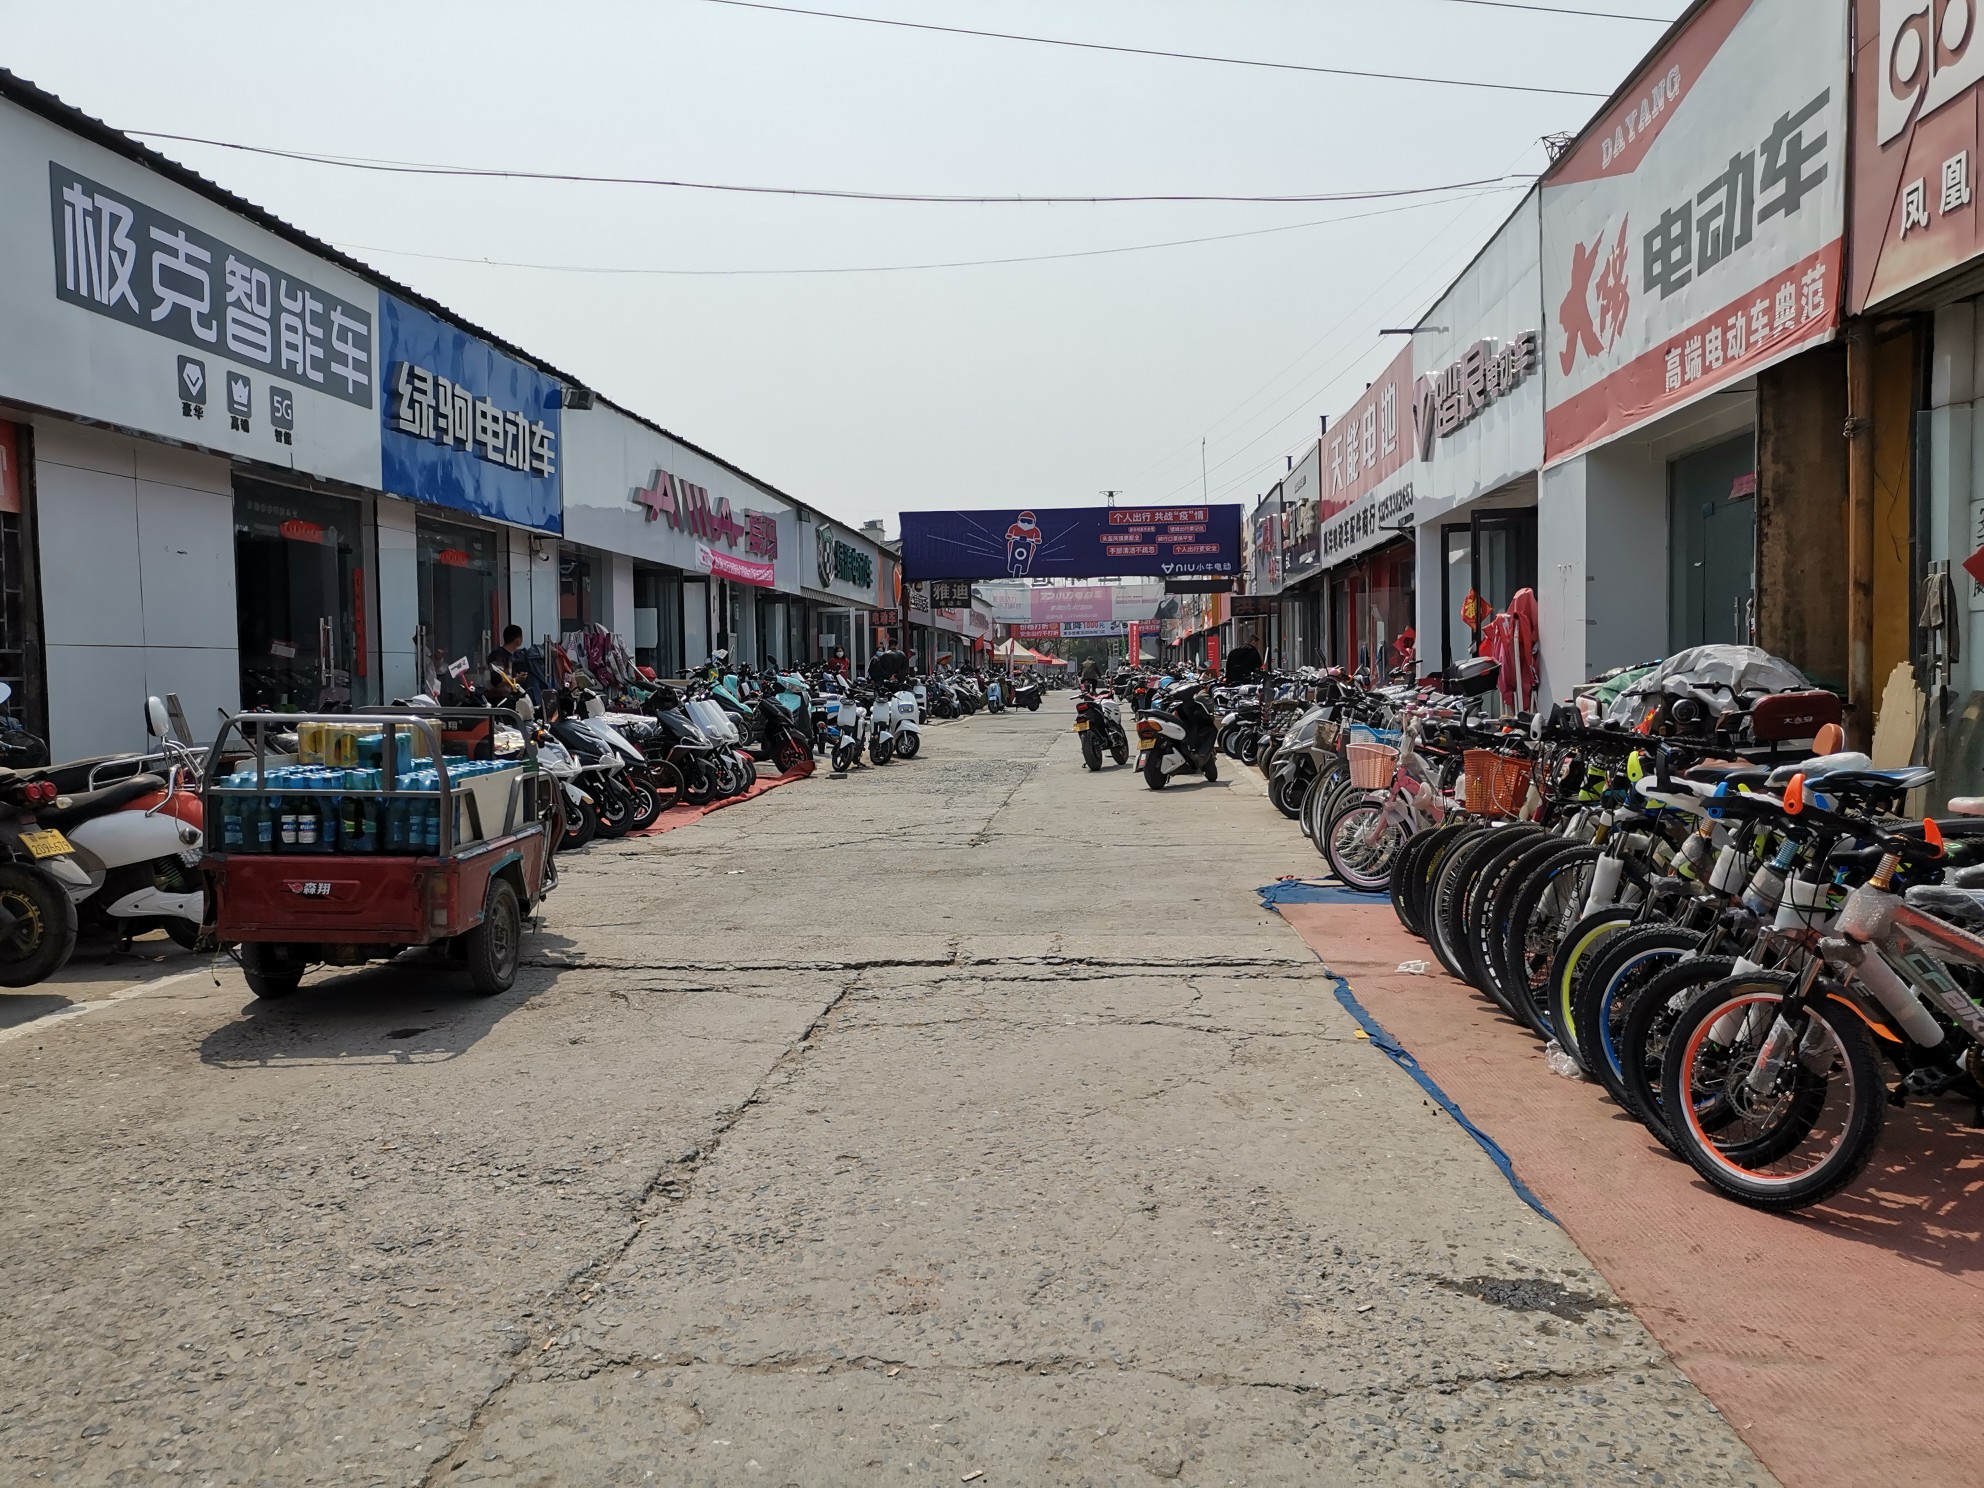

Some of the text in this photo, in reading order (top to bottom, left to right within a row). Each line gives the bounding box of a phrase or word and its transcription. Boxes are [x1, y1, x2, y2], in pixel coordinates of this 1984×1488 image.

[1601, 64, 1681, 170] DAYANG
[1643, 86, 1831, 301] 电动车
[1899, 149, 1971, 240] 凤凰
[62, 181, 369, 395] 极克智能车
[1664, 263, 1827, 393] 高端电动车典范
[273, 395, 292, 421] 5G
[397, 361, 557, 479] 绿驹电动车
[1330, 381, 1398, 497] 天能电池
[1113, 511, 1151, 523] 个人出行
[932, 583, 969, 600] 雅迪
[1196, 562, 1232, 571] 小牛电动
[872, 611, 897, 625] 电动车
[303, 881, 331, 895] 森翔
